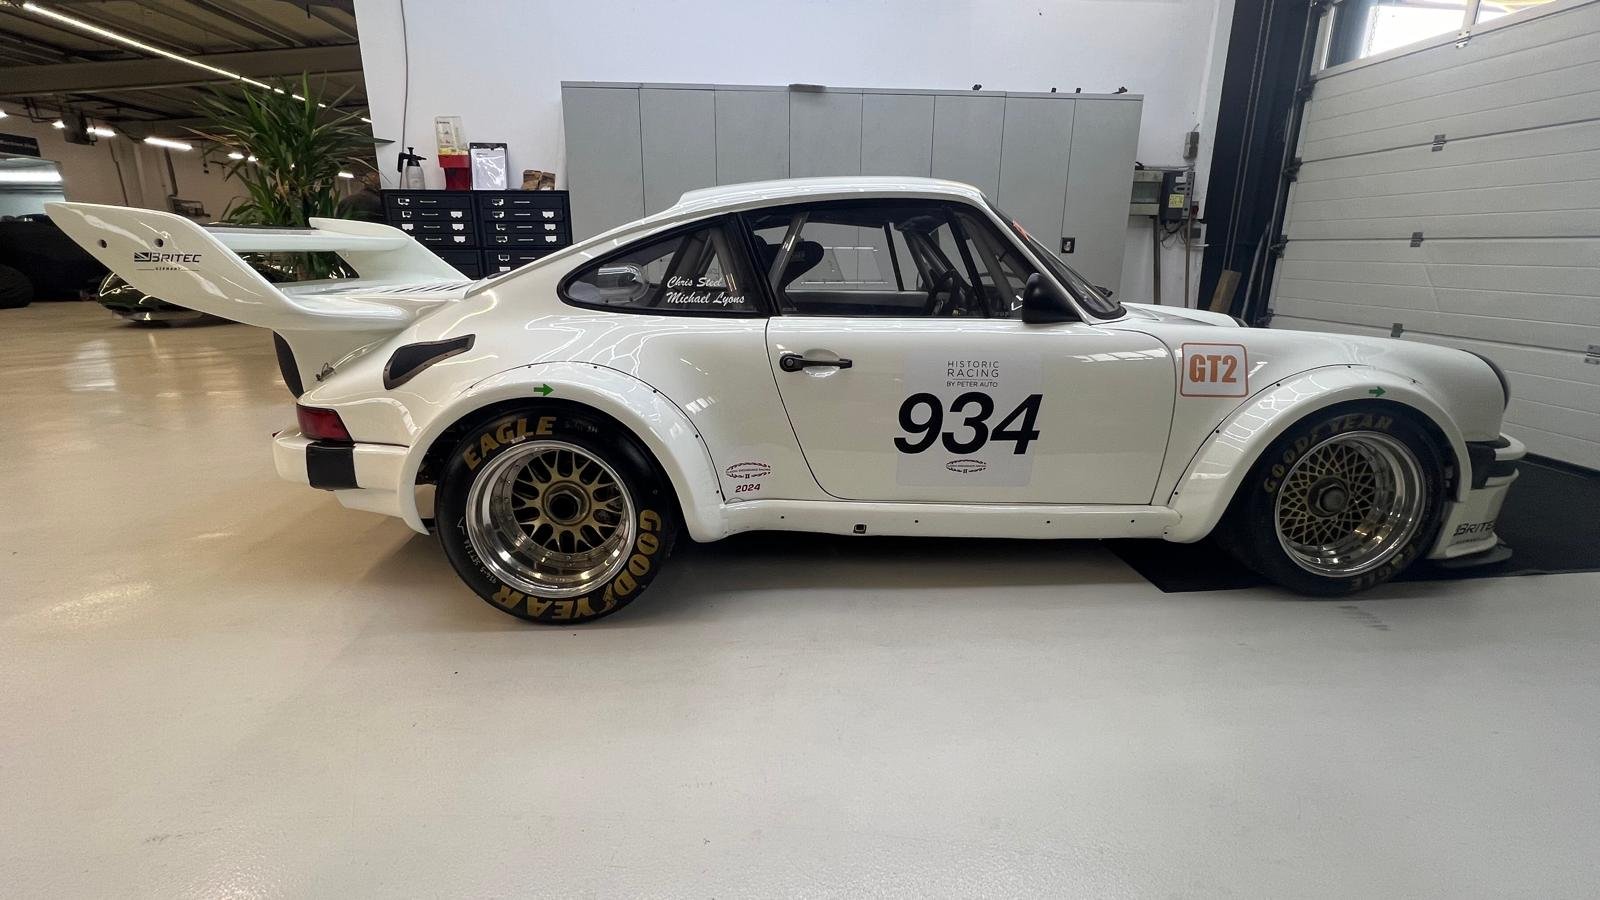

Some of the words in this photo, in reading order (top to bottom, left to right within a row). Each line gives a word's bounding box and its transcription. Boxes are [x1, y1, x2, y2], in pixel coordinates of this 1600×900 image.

[147, 252, 202, 263] BRITEC
[666, 275, 694, 288] Chris
[666, 291, 711, 304] Michael
[712, 291, 745, 307] Lyons
[947, 360, 1000, 369] HISTORIC
[1189, 354, 1238, 383] GT2
[947, 368, 999, 378] RACING
[894, 391, 1043, 455] 934
[463, 415, 557, 471] EAGLE
[735, 483, 761, 493] 2024
